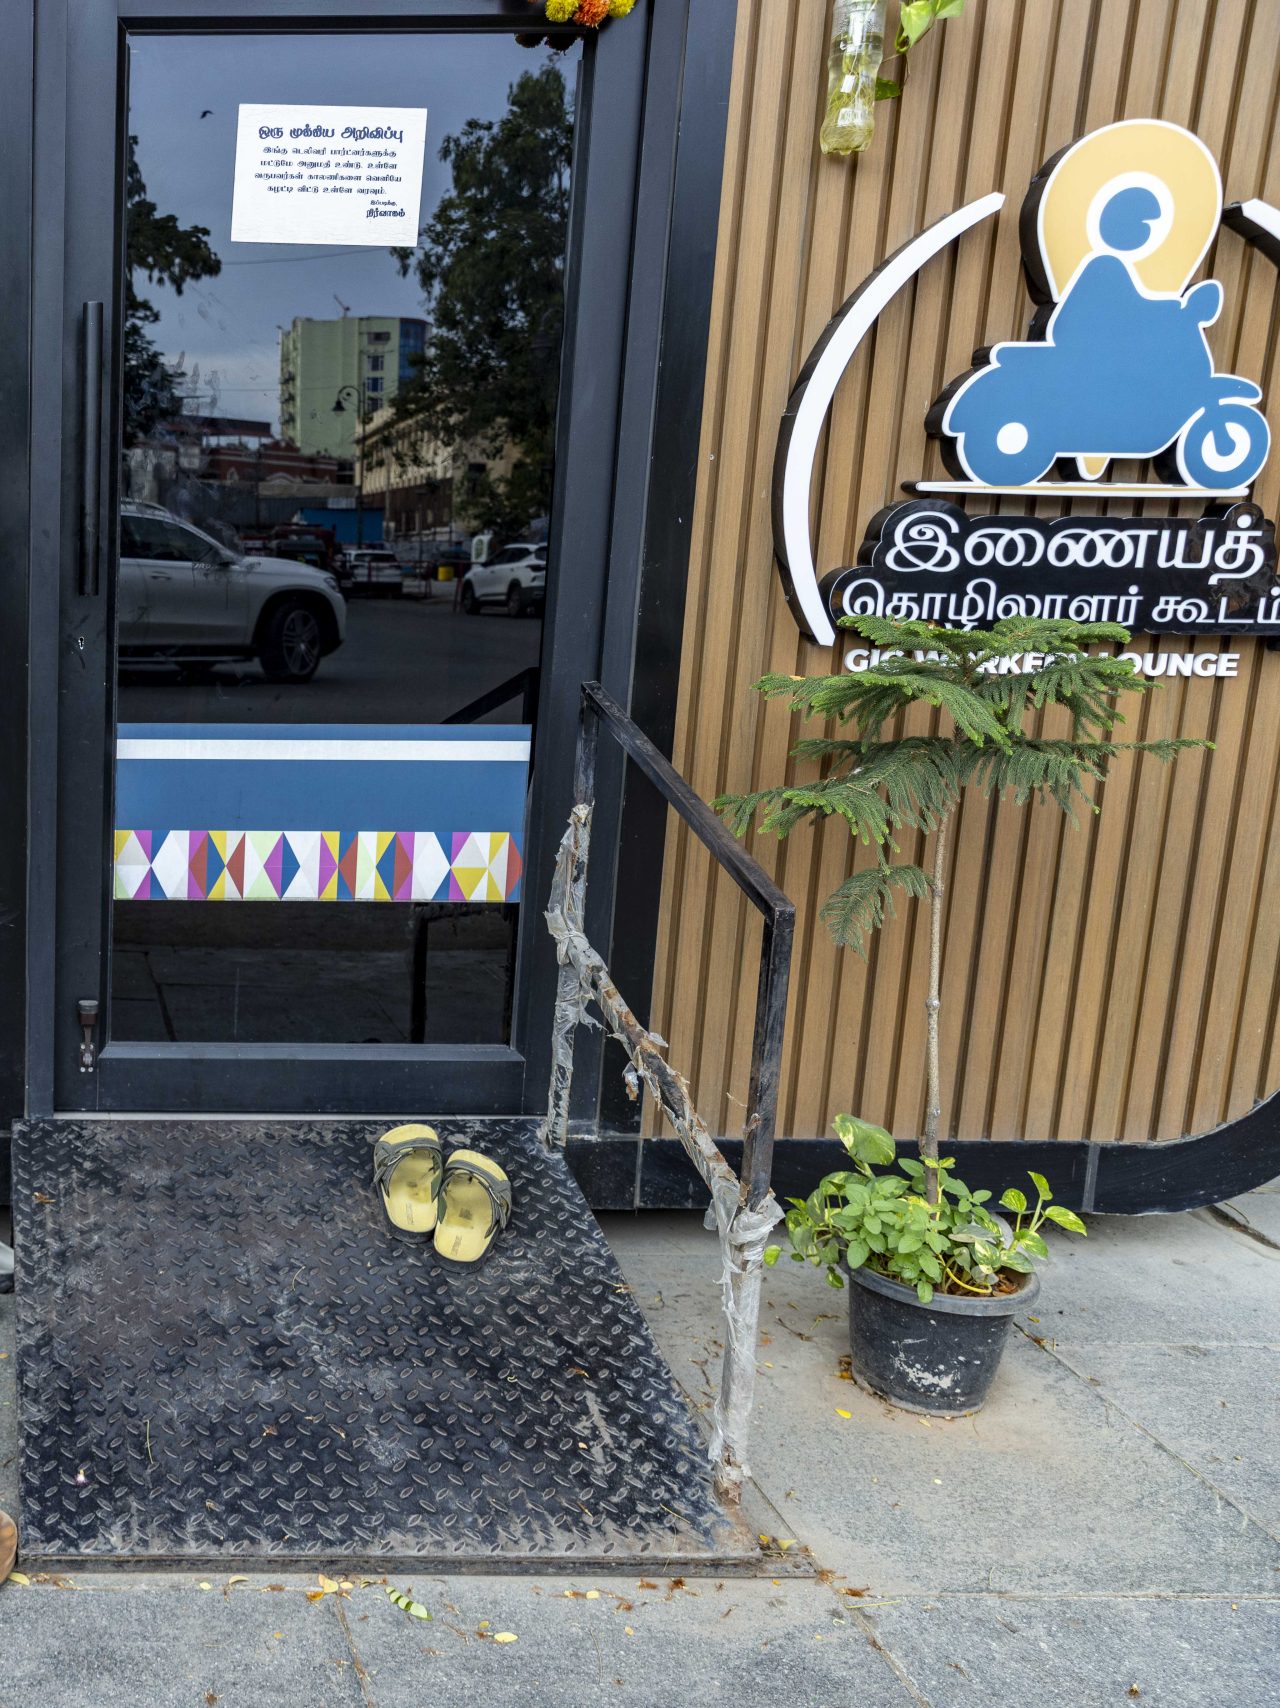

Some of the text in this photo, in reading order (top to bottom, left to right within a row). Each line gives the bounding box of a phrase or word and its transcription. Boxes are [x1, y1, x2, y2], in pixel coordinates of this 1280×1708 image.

[258, 123, 404, 144] ஒரு முக்கிய அறிவிப்பு
[262, 145, 288, 156] இங்கு
[260, 159, 294, 168] மட்டுமே
[297, 160, 331, 170] அனுமதி
[367, 161, 398, 170] உள்ளே
[254, 171, 402, 183] வருபவர்கள் காலணிகளை வெளியே
[297, 184, 319, 194] விட்டு
[322, 185, 353, 194] உள்ளே
[365, 207, 406, 219] நிர்வாகம்
[884, 510, 1266, 586] இணையத்
[1097, 651, 1241, 677] OUNGE
